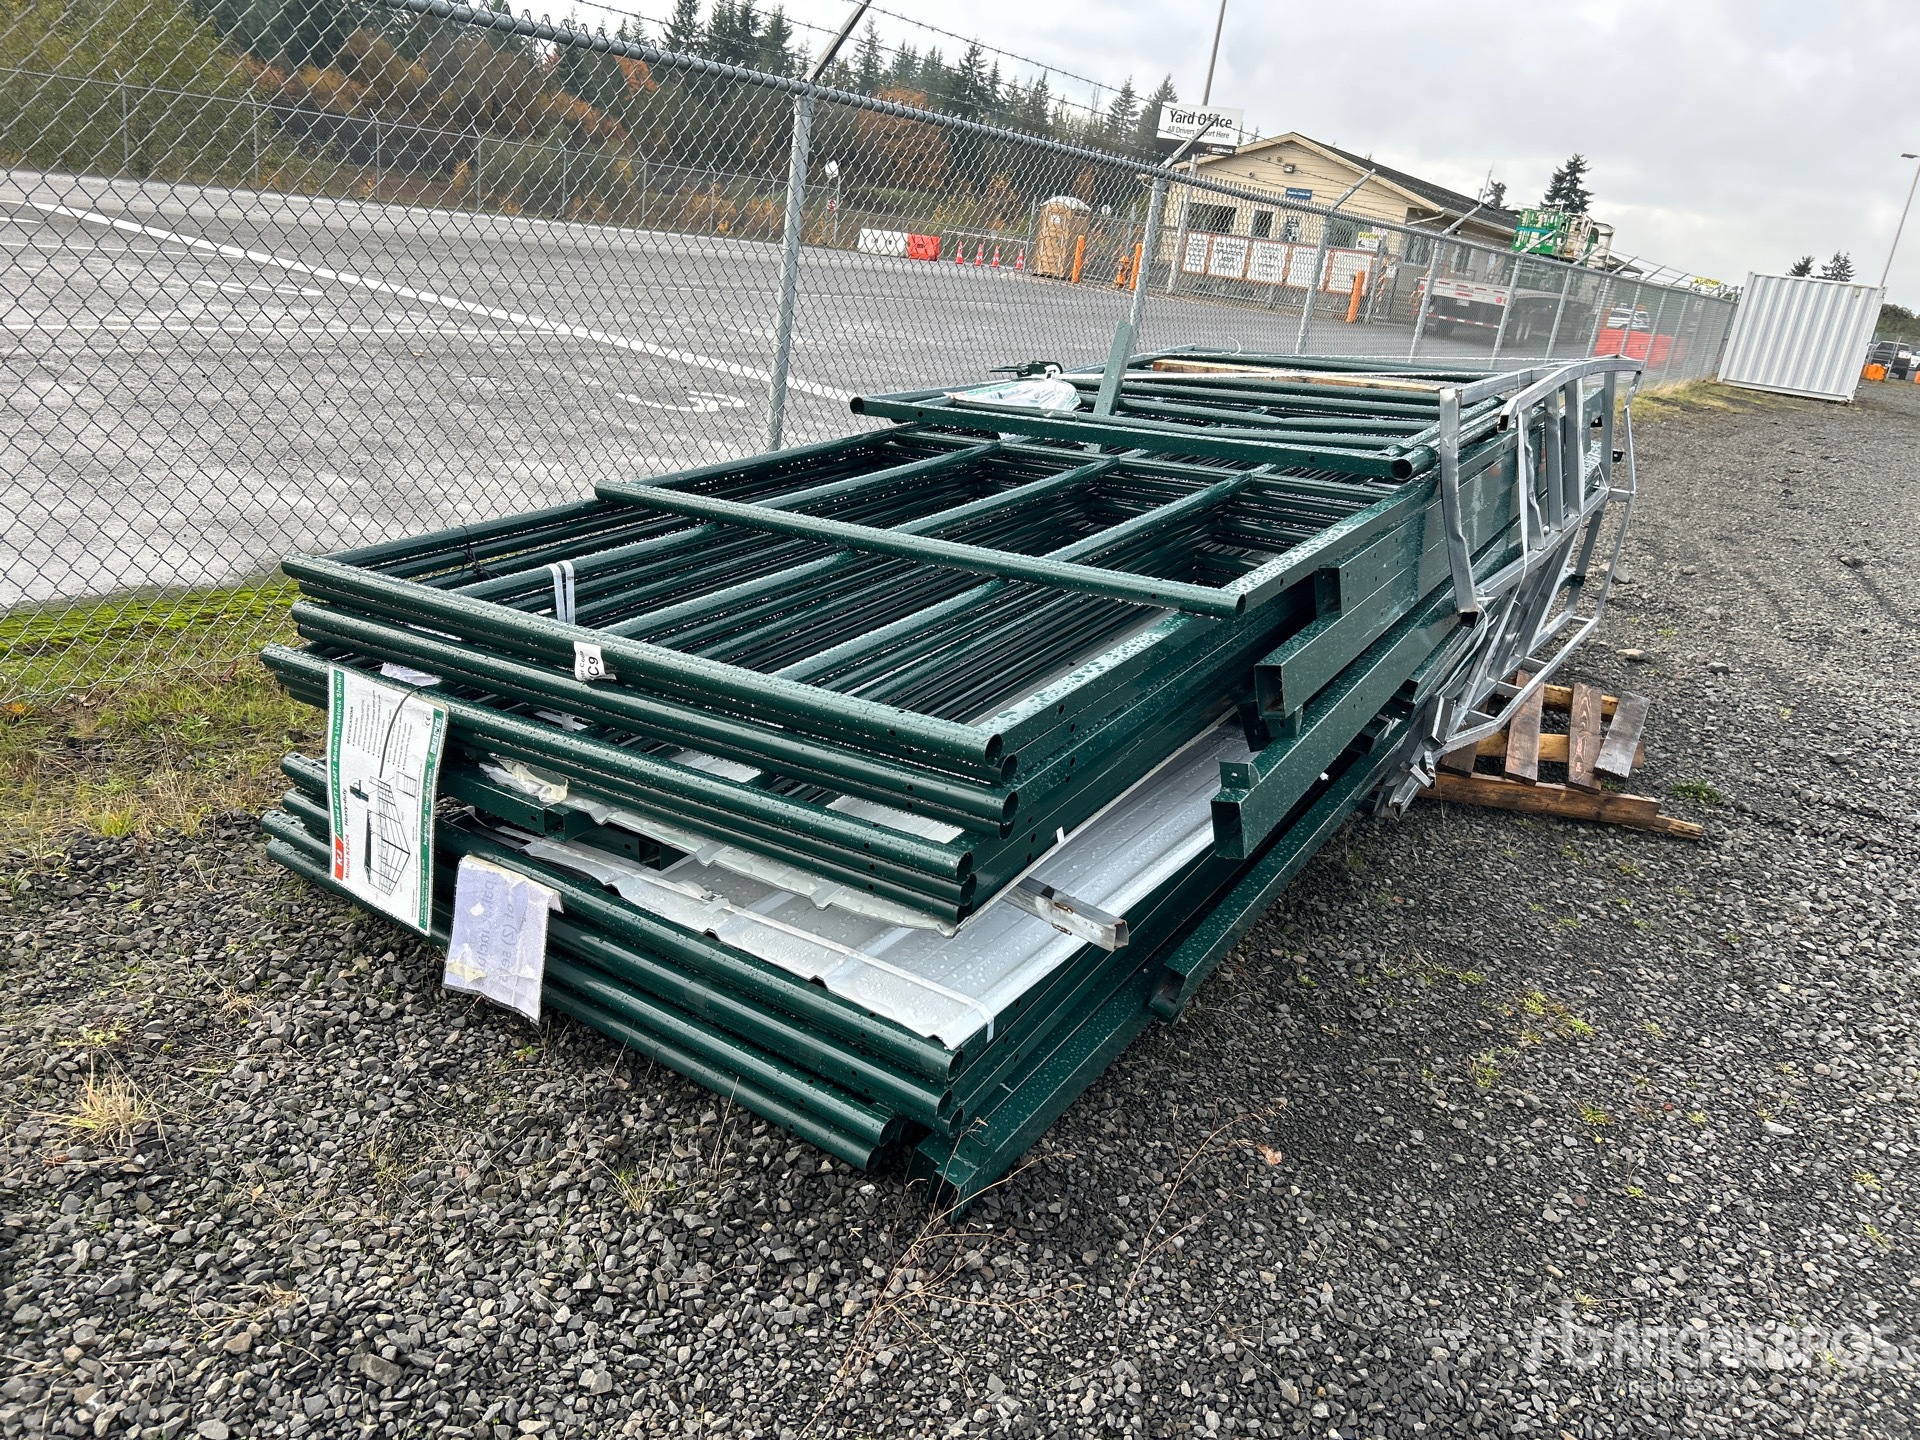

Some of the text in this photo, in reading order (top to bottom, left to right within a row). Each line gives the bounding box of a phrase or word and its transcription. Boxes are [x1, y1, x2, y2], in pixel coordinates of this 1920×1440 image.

[1170, 110, 1195, 125] Yard
[1176, 127, 1195, 135] Drivers
[1216, 131, 1230, 139] Here
[336, 672, 344, 698] Shelter
[334, 700, 342, 735] Livestock
[332, 736, 340, 762] Module
[336, 849, 343, 866] KJ
